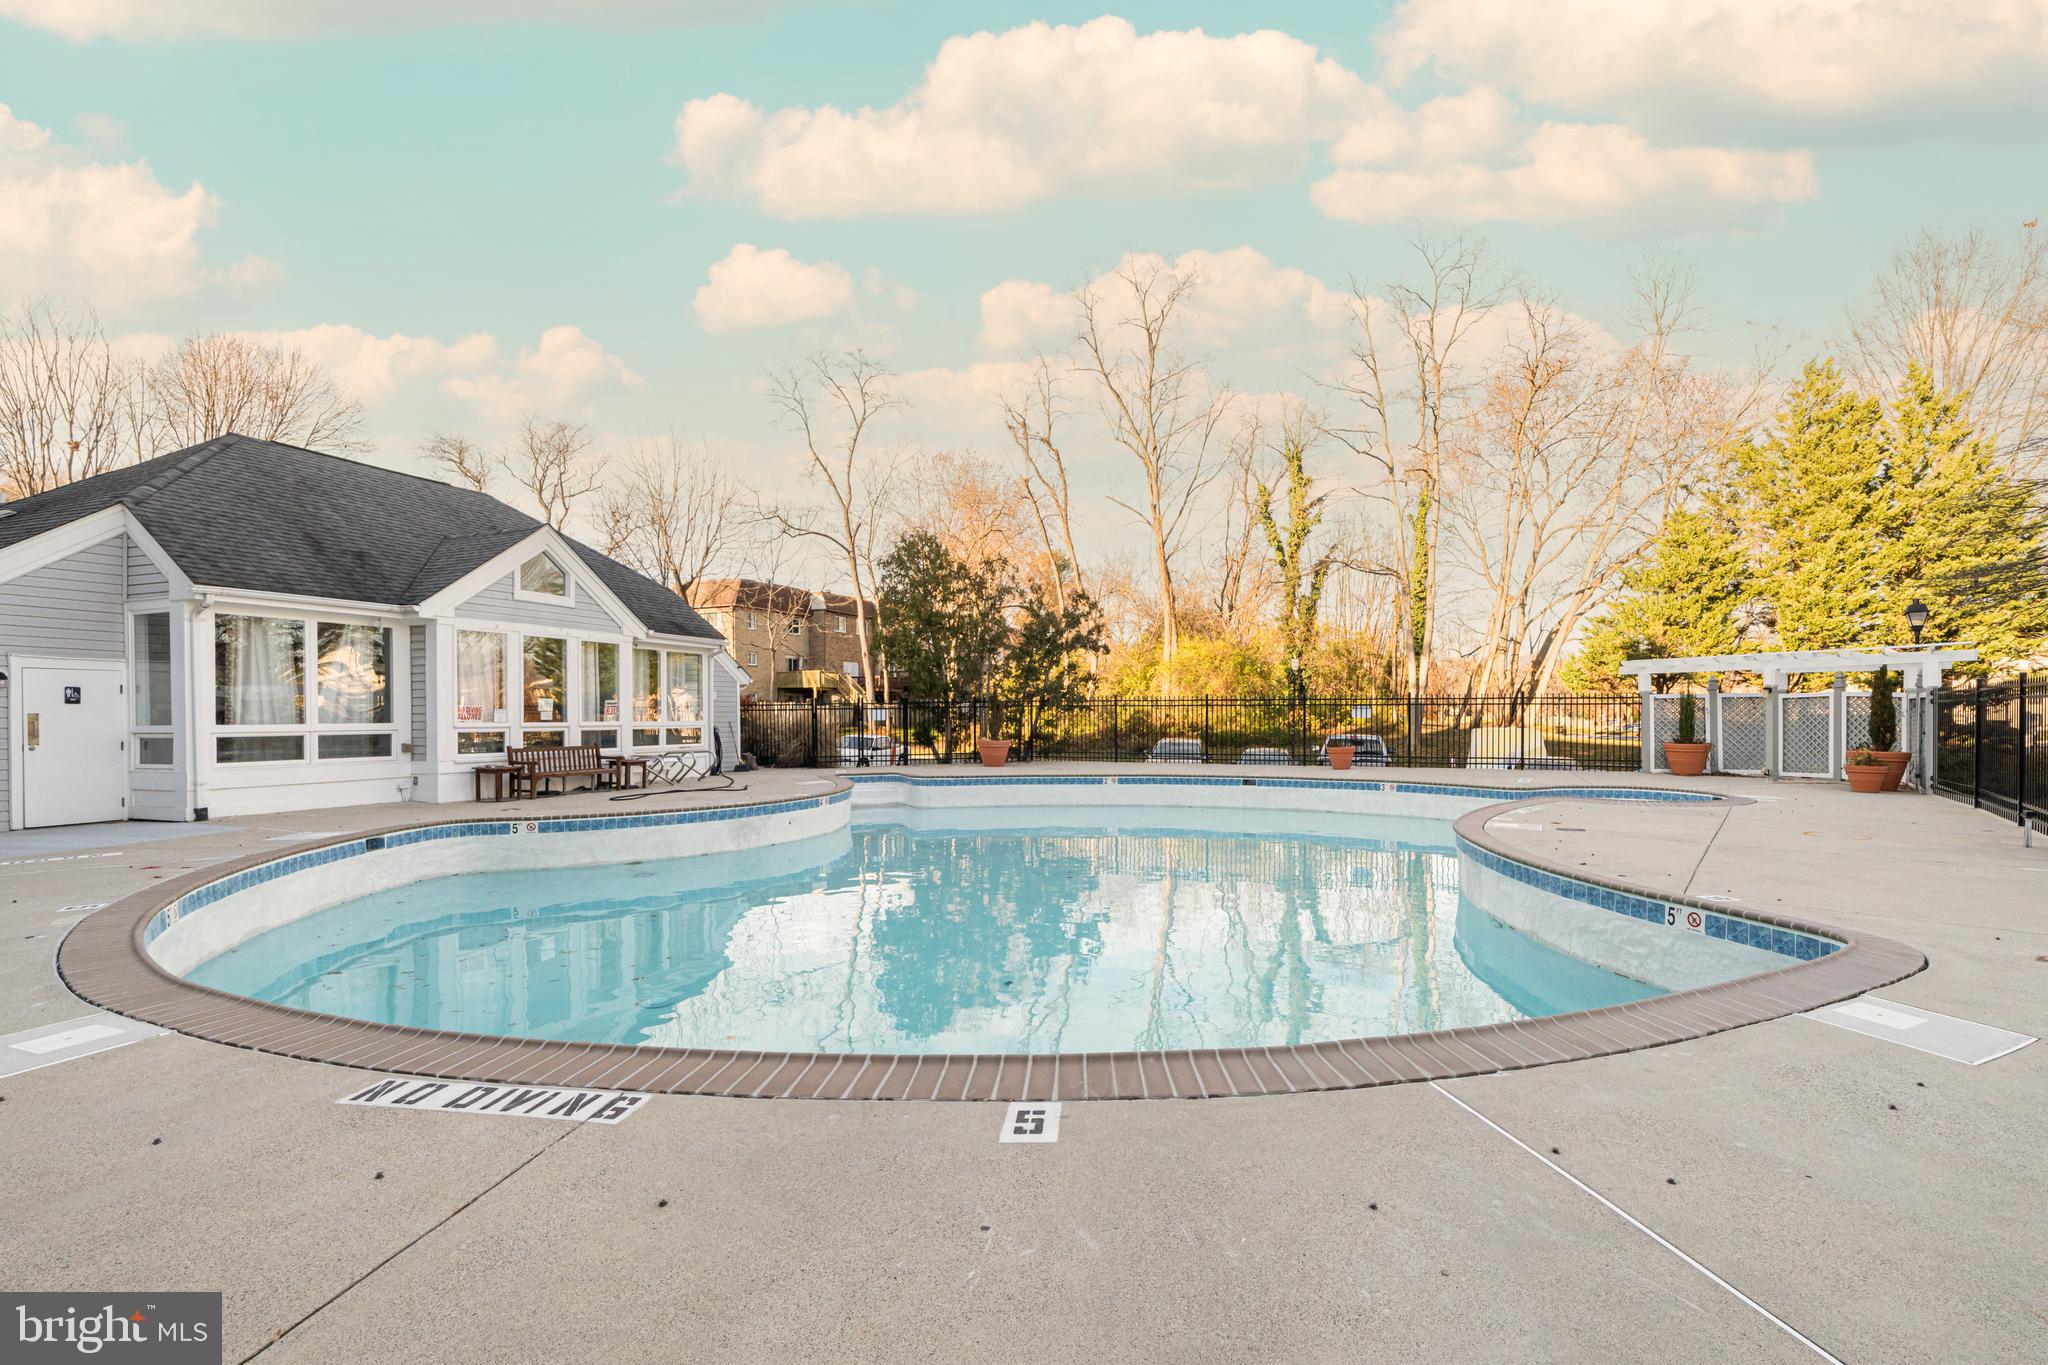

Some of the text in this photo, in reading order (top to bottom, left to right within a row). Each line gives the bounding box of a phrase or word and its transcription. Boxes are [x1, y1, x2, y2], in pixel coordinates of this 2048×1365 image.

[512, 823, 518, 834] 5
[1667, 906, 1675, 926] 5
[349, 1080, 642, 1120] NO DIVING
[1013, 1110, 1046, 1135] 5
